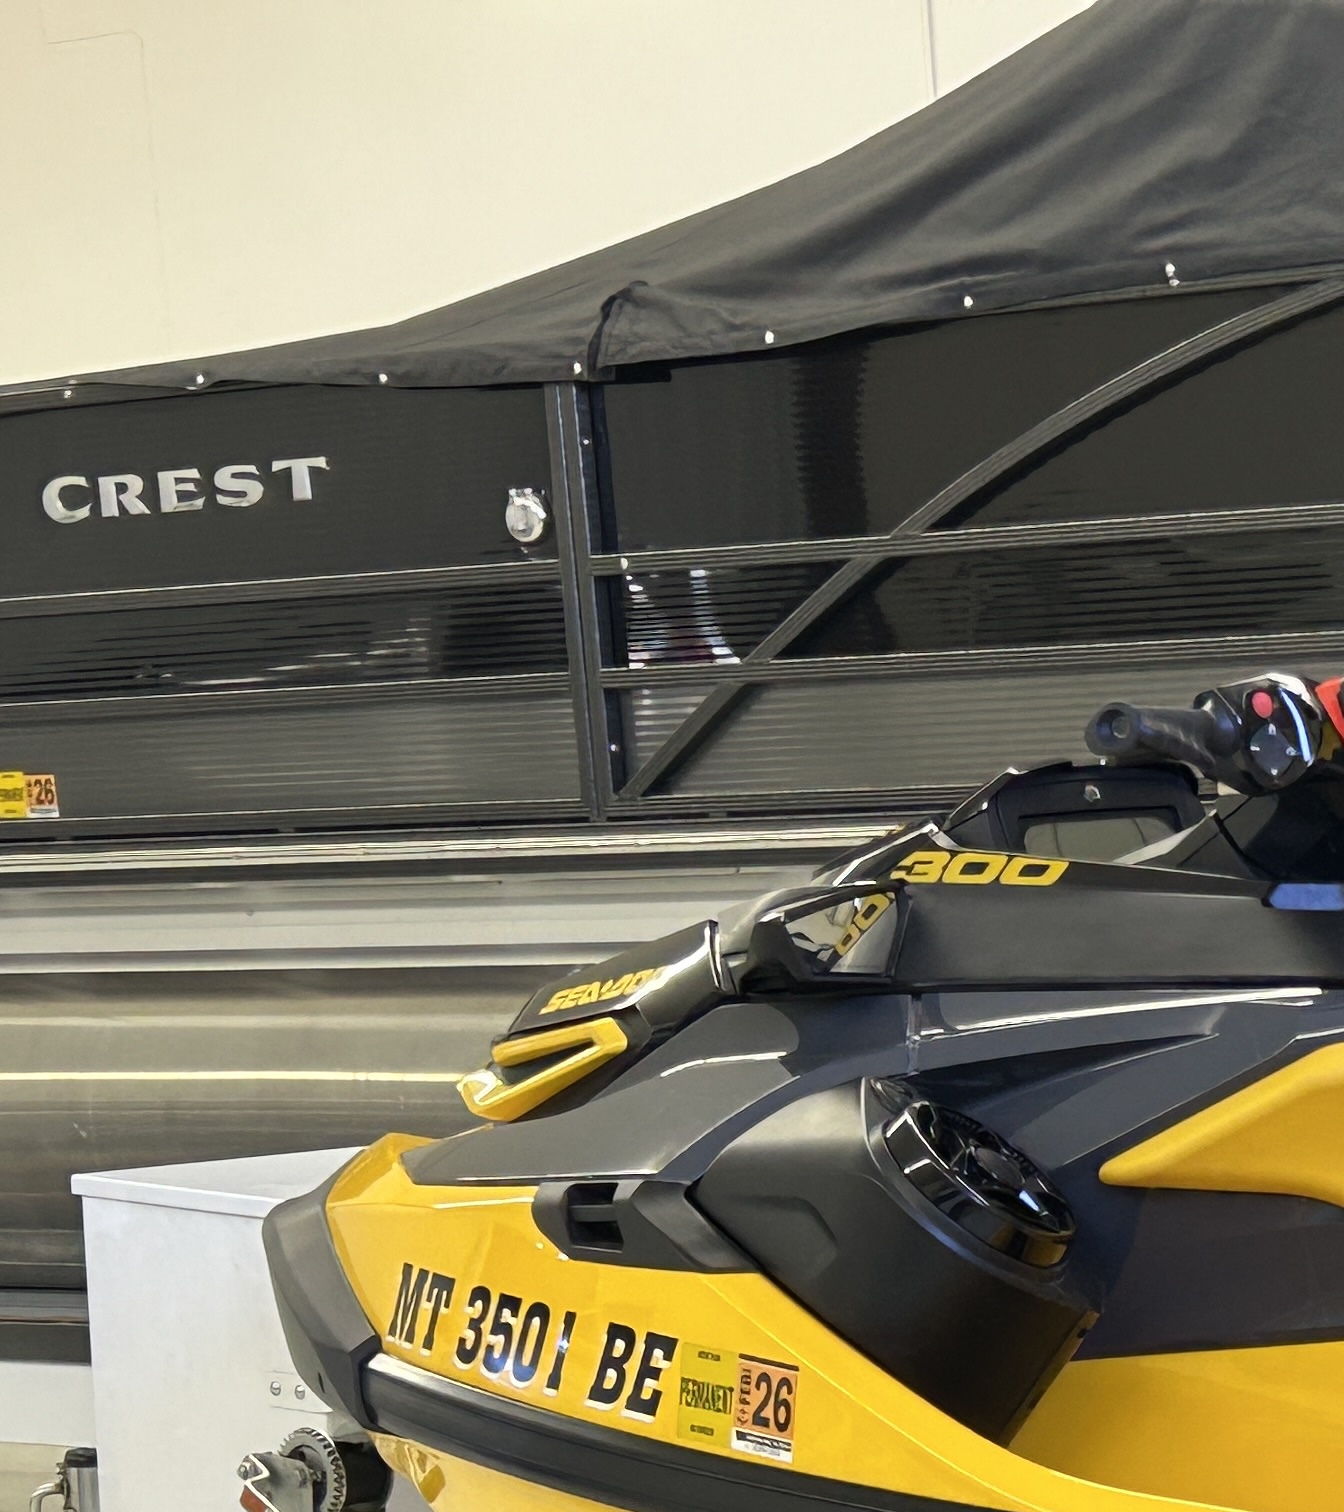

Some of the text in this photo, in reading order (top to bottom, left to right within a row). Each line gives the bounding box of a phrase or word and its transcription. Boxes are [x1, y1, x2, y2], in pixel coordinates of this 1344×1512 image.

[42, 456, 331, 524] CREST
[890, 850, 1070, 887] 300
[387, 1262, 679, 1423] MT 3501 BE
[751, 1371, 793, 1433] 26
